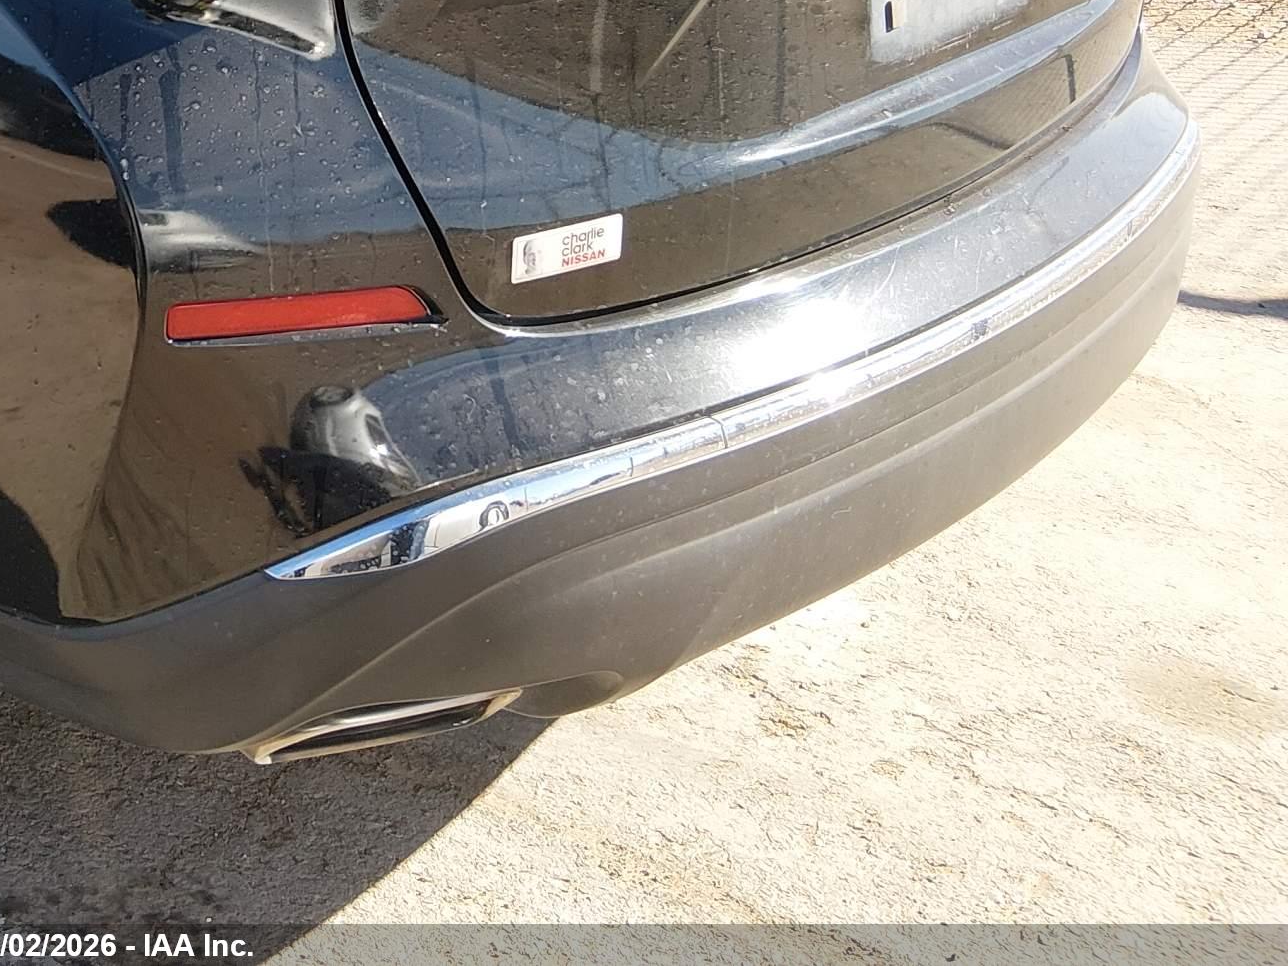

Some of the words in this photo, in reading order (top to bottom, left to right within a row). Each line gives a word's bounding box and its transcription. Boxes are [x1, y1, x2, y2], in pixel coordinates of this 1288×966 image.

[562, 227, 605, 246] charlie
[561, 240, 594, 257] clark
[561, 249, 606, 268] NISSAN
